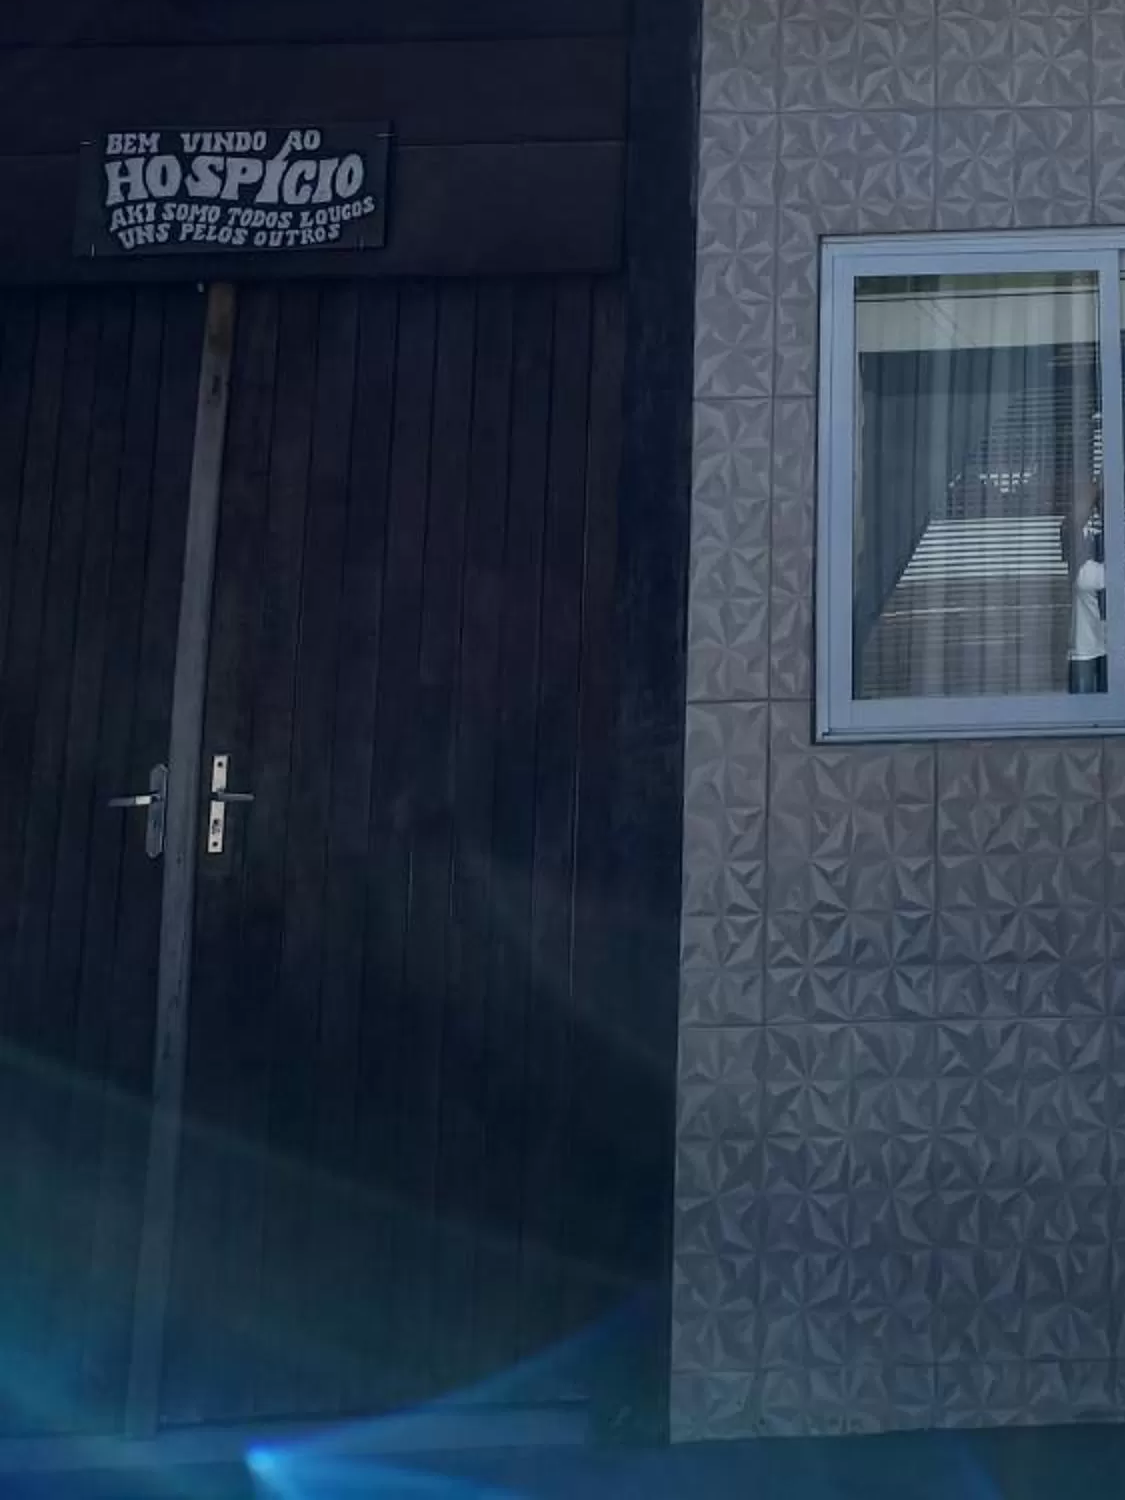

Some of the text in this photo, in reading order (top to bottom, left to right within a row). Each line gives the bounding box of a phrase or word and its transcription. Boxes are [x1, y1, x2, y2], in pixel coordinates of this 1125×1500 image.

[106, 129, 321, 154] BEM VINDO AO
[105, 153, 365, 206] HOSPÍCIO
[109, 196, 376, 232] AKI SOMO TODOS LOUCOS
[117, 223, 341, 250] UNS PELOS OUTROS
